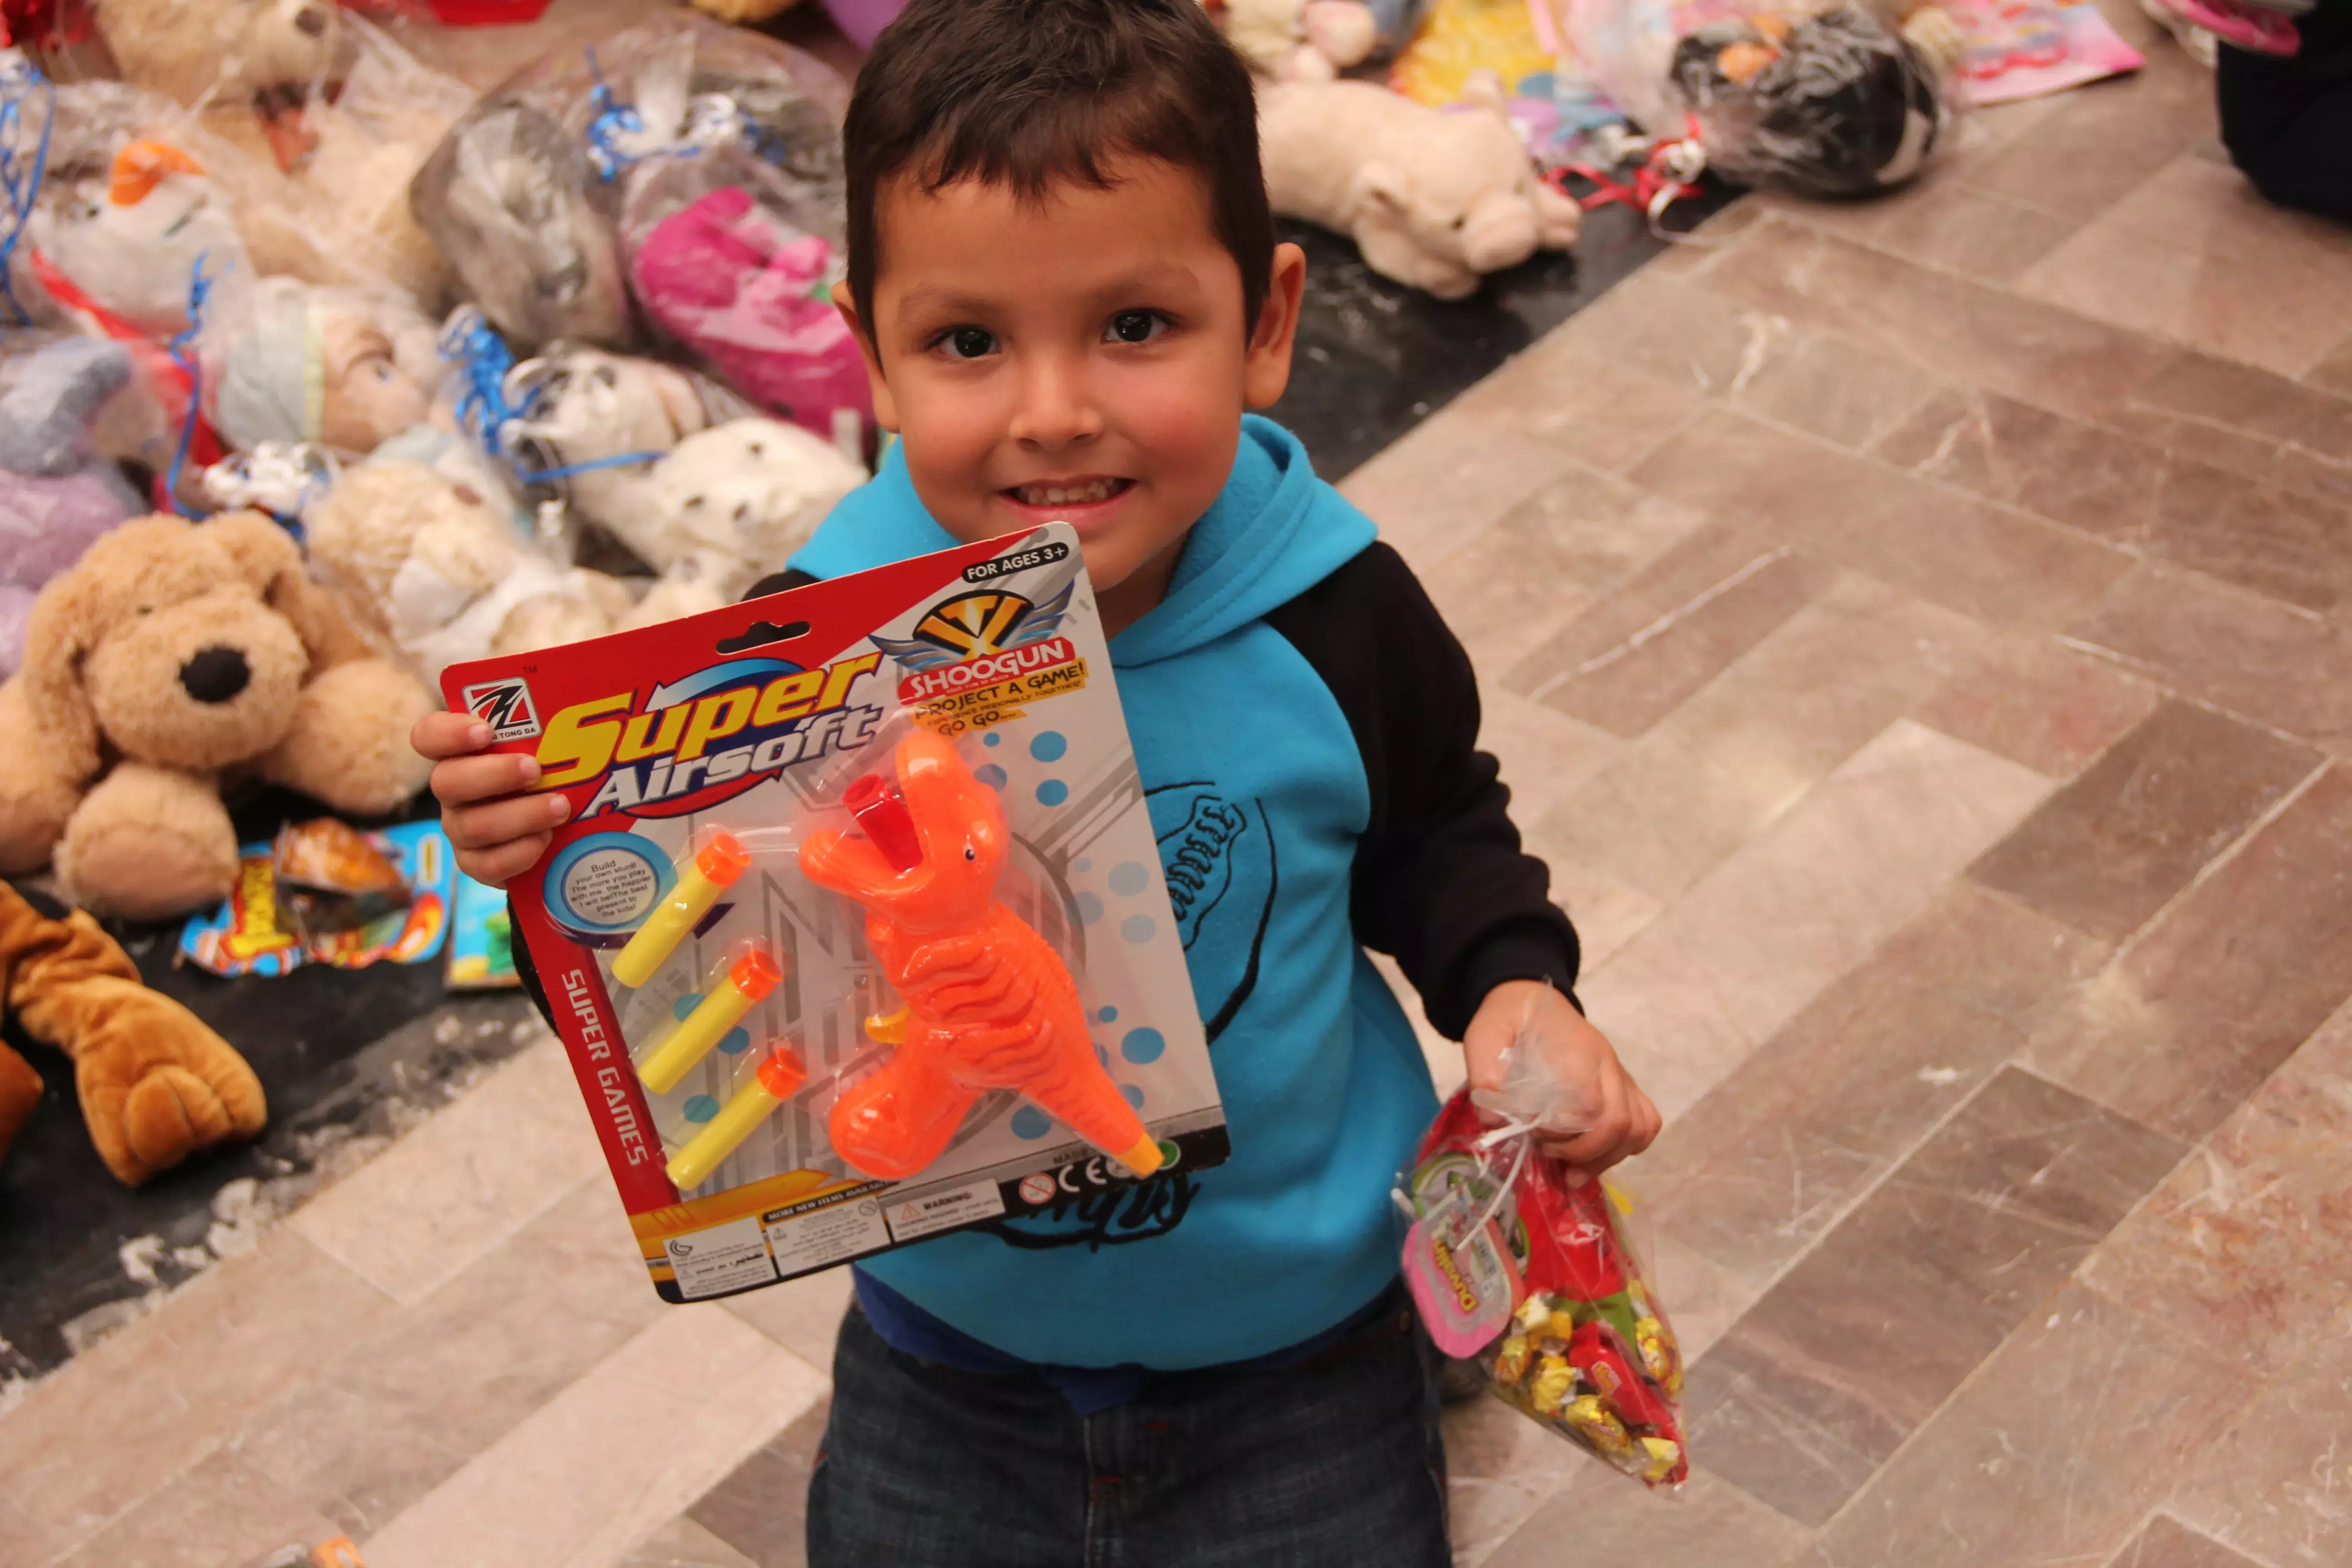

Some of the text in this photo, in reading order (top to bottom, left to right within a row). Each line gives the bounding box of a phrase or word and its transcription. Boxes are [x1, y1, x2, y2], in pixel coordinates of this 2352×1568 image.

[967, 548, 1065, 579] FOR AGES 3+
[912, 640, 1065, 699] SHOOGUN
[915, 662, 1084, 719] PROJECT A GAME!
[534, 652, 884, 790] Super
[938, 720, 965, 736] GO
[500, 730, 522, 738] TONG
[573, 705, 884, 822] Airsoft
[575, 876, 593, 885] your
[595, 870, 612, 878] own
[591, 860, 616, 872] Build
[570, 893, 587, 902] with
[621, 875, 652, 887] happier
[590, 879, 610, 888] more
[612, 874, 627, 883] you
[629, 869, 646, 878] play
[630, 885, 648, 893] best
[597, 898, 627, 912] present
[562, 969, 649, 1166] SUPER GAMES
